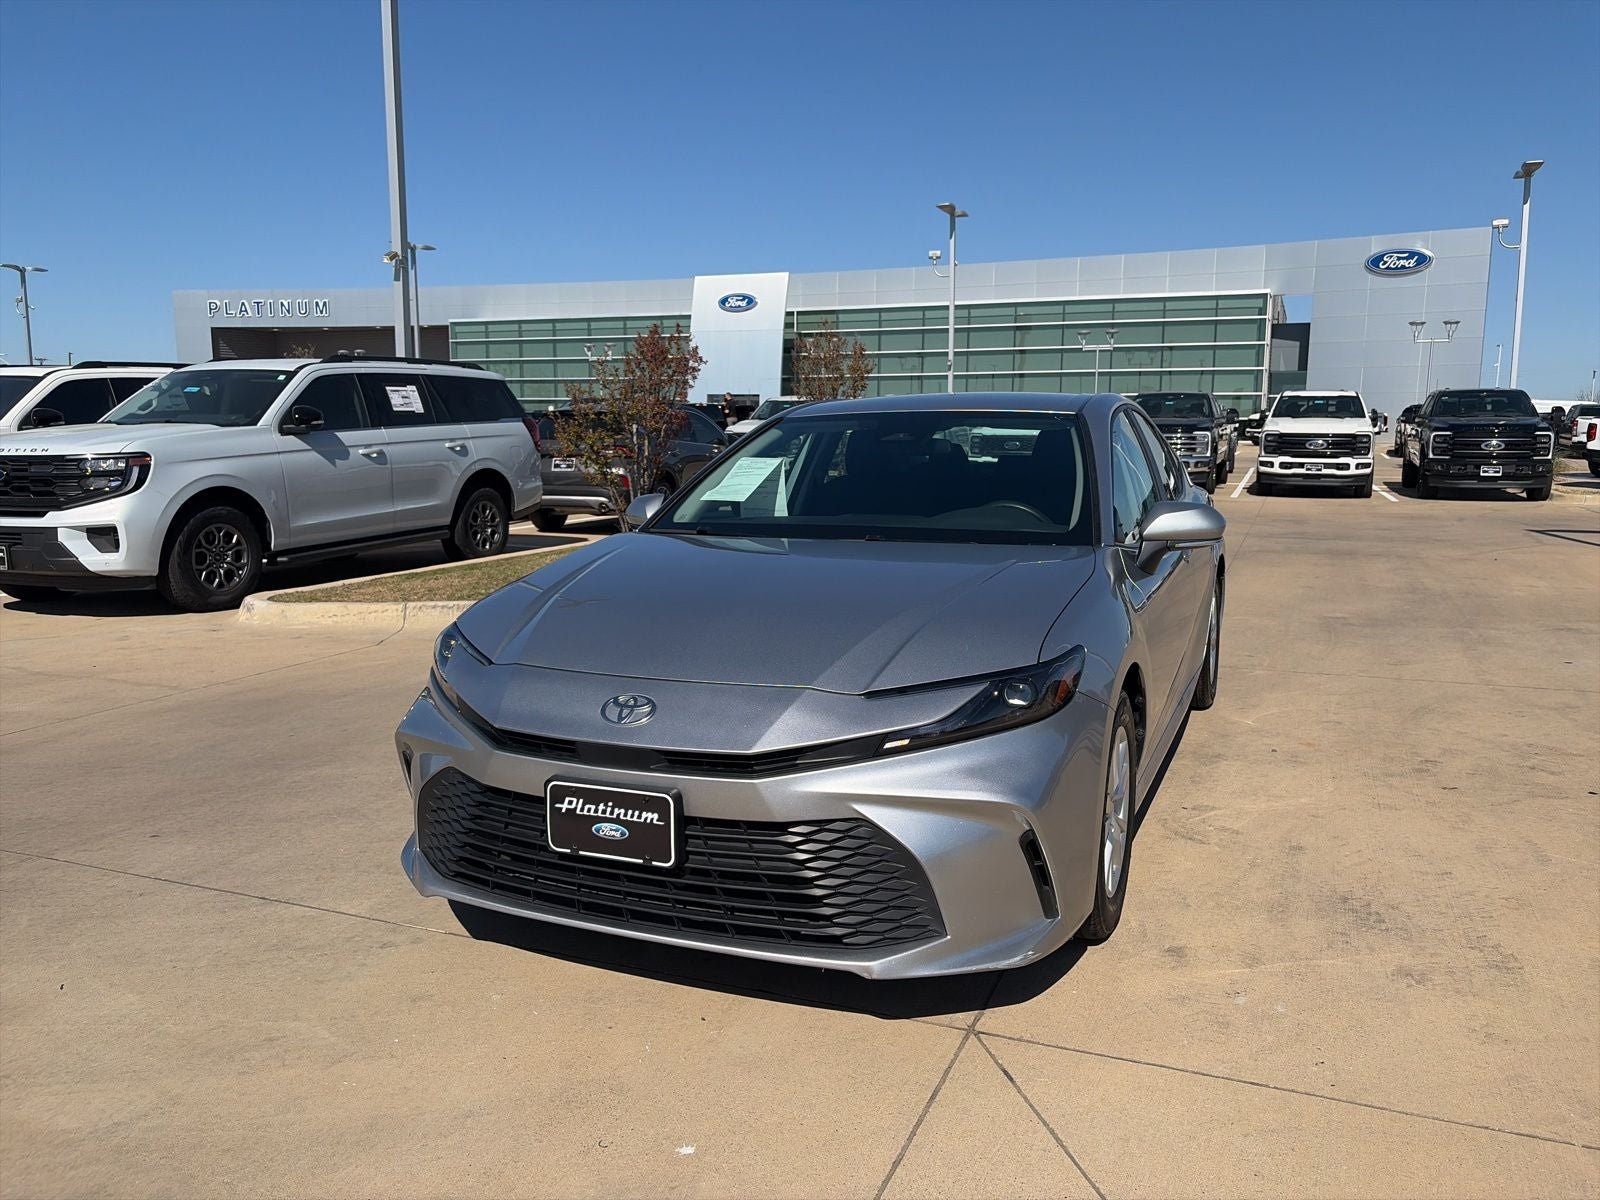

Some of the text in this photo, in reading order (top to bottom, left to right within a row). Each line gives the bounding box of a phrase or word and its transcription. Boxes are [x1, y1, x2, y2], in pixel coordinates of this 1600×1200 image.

[1379, 252, 1418, 269] Ford
[207, 299, 329, 317] PLATINUM
[725, 296, 748, 307] Ford
[554, 796, 665, 825] Platinum
[599, 825, 622, 838] Ford
